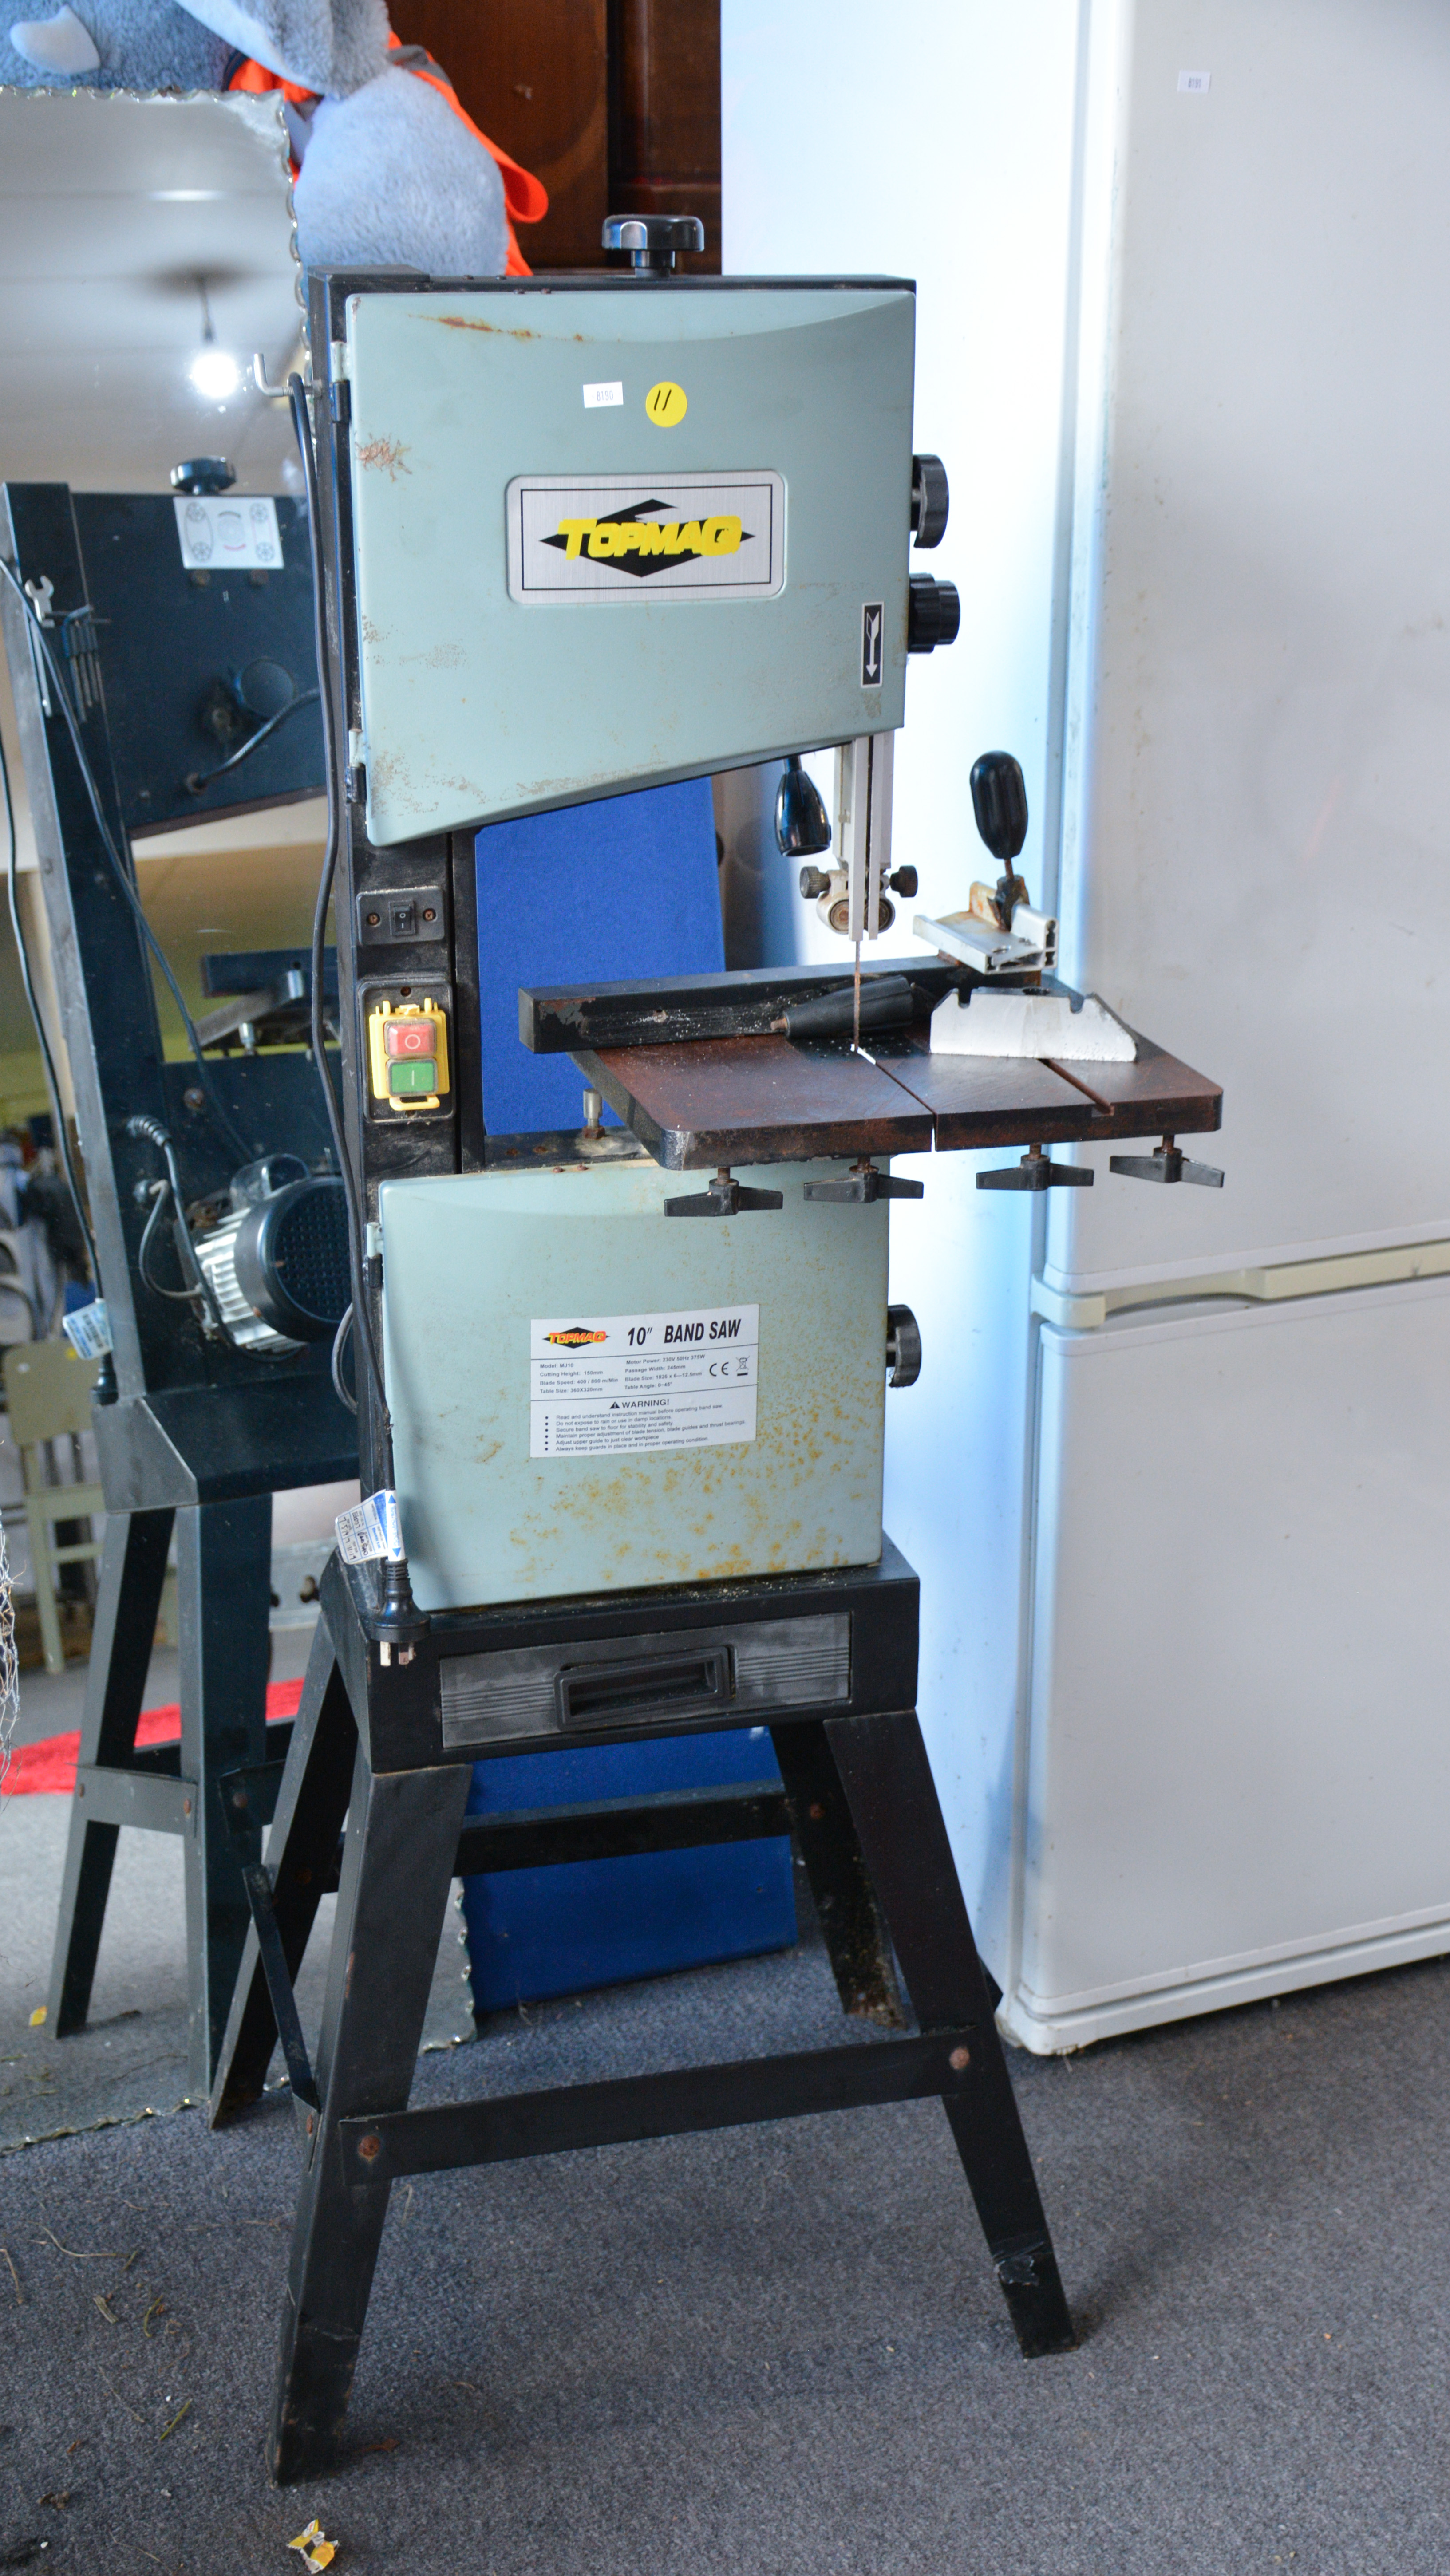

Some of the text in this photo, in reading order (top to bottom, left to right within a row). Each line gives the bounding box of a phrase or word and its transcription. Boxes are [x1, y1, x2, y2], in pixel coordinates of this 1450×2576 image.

[597, 390, 613, 401] 8190
[664, 1322, 704, 1344] BAND
[709, 1318, 741, 1340] SAW
[622, 1399, 669, 1408] WARNING!
